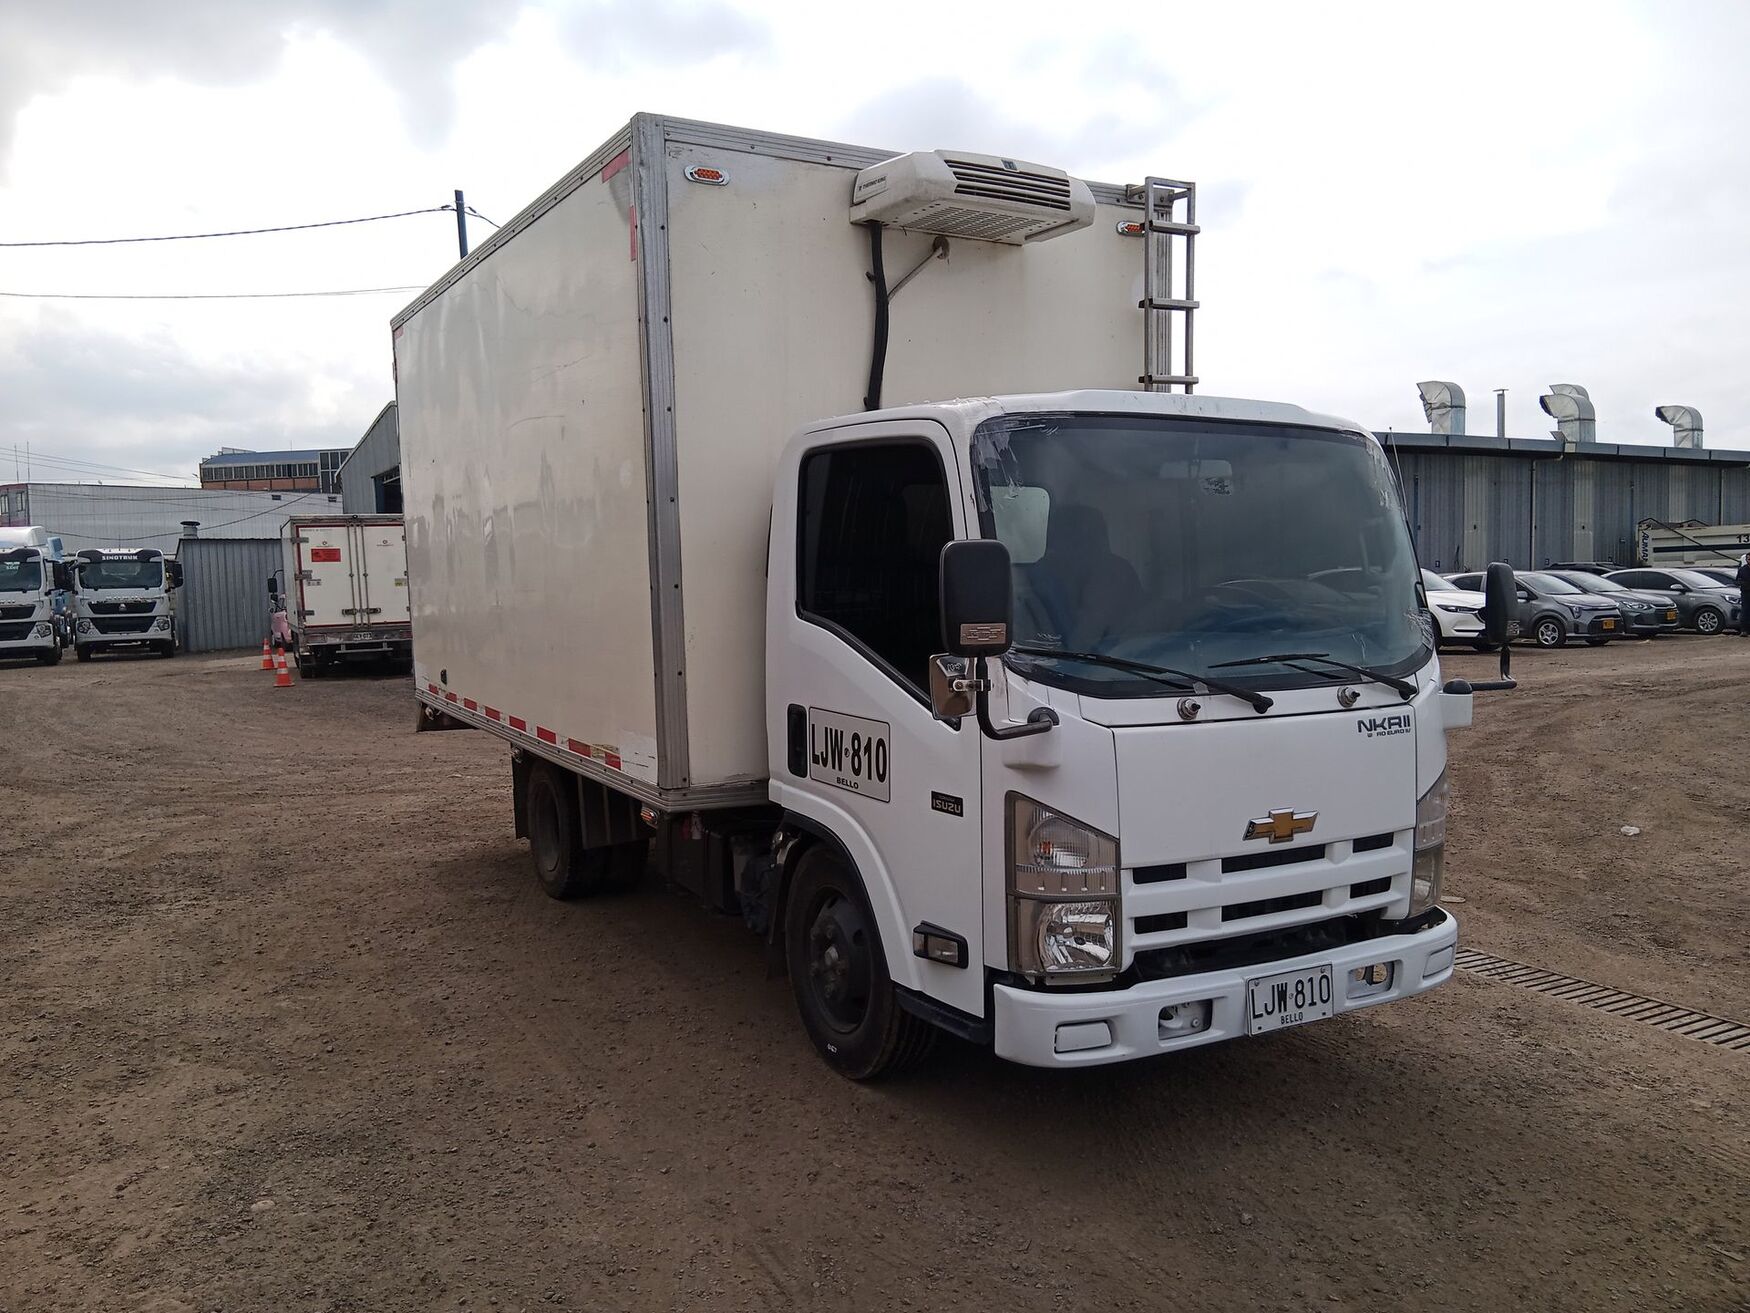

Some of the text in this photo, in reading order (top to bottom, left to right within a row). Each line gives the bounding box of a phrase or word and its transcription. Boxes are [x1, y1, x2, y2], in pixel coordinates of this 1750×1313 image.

[811, 723, 887, 783] LJW 810
[836, 776, 859, 790] BELLO
[933, 798, 961, 813] ISUZU
[1251, 974, 1331, 1019] LJW 810
[1280, 1011, 1304, 1025] BELLO
